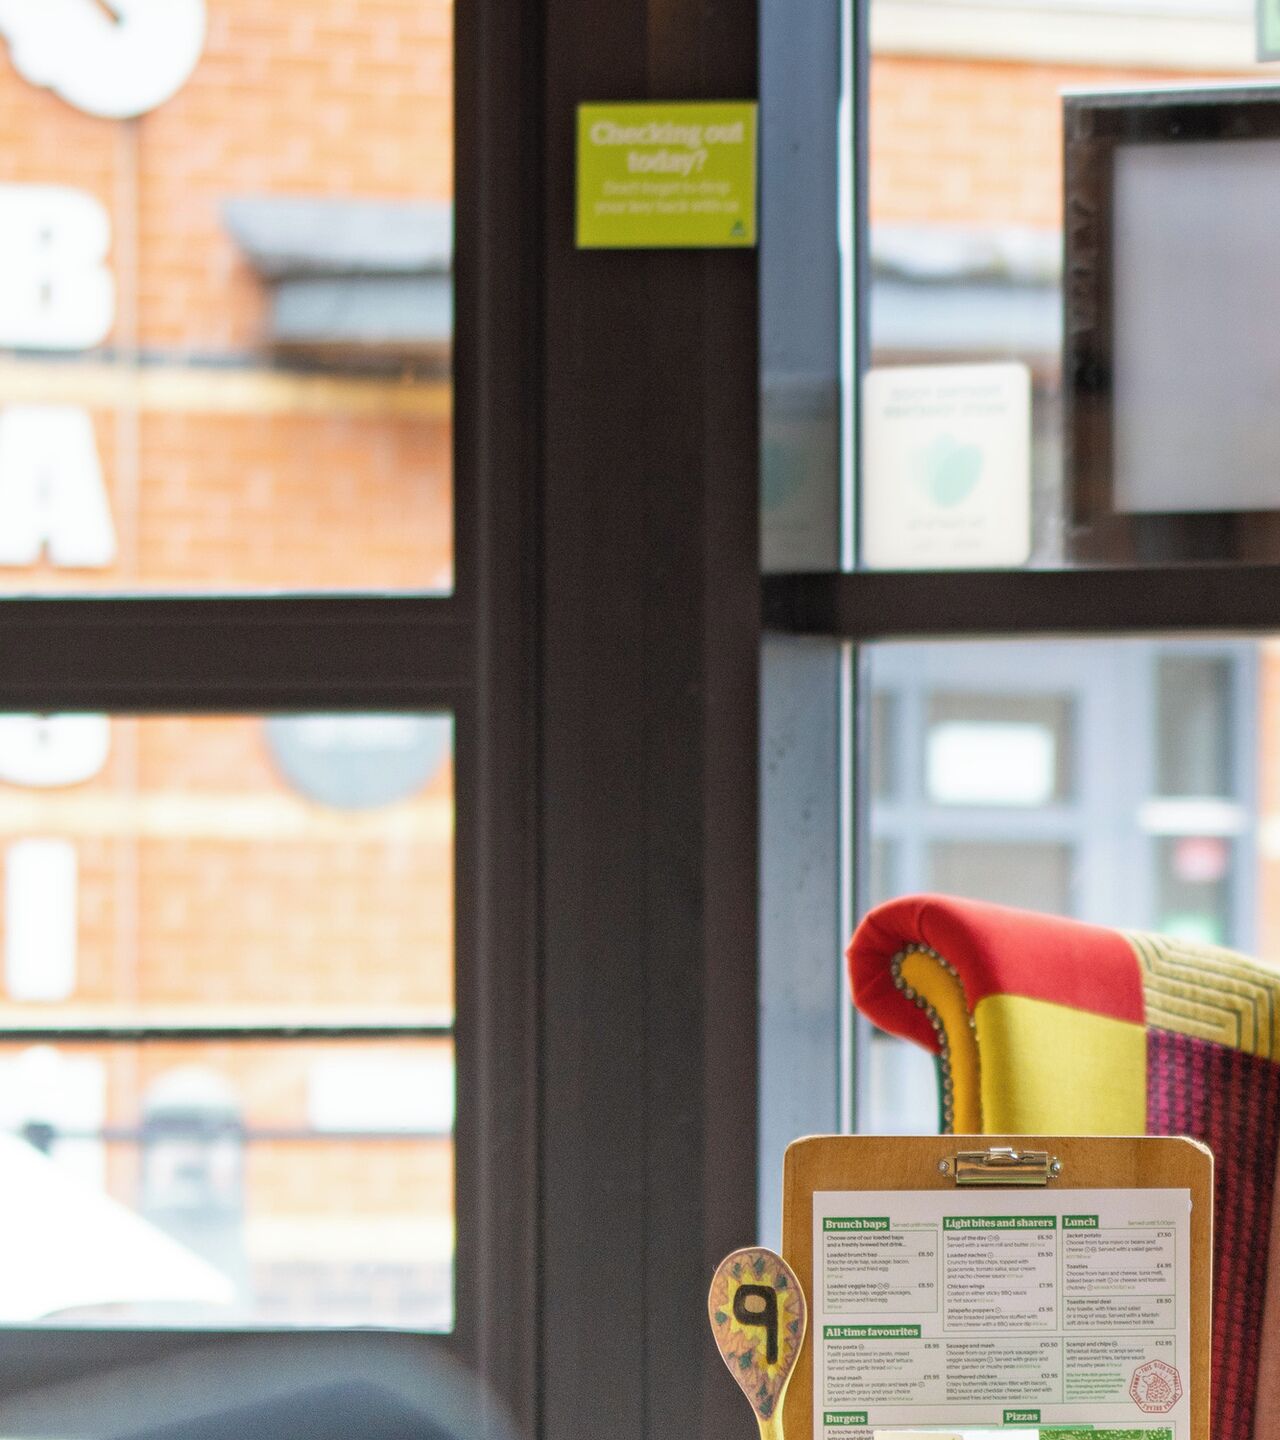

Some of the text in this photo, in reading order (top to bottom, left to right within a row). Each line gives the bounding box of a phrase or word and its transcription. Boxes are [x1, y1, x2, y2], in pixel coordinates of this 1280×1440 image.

[590, 120, 743, 148] Checking out
[627, 149, 709, 177] today?
[825, 1220, 862, 1230] Brunch
[863, 1220, 888, 1230] baps
[945, 1219, 971, 1227] Light
[971, 1219, 996, 1227] bites
[996, 1219, 1016, 1227] and
[1016, 1219, 1053, 1227] sharers
[1064, 1218, 1096, 1227] Lunch
[733, 1284, 778, 1365] 9
[826, 1328, 919, 1337] All-time favourites
[826, 1415, 866, 1425] Burgers
[1006, 1411, 1038, 1421] Pizzas
